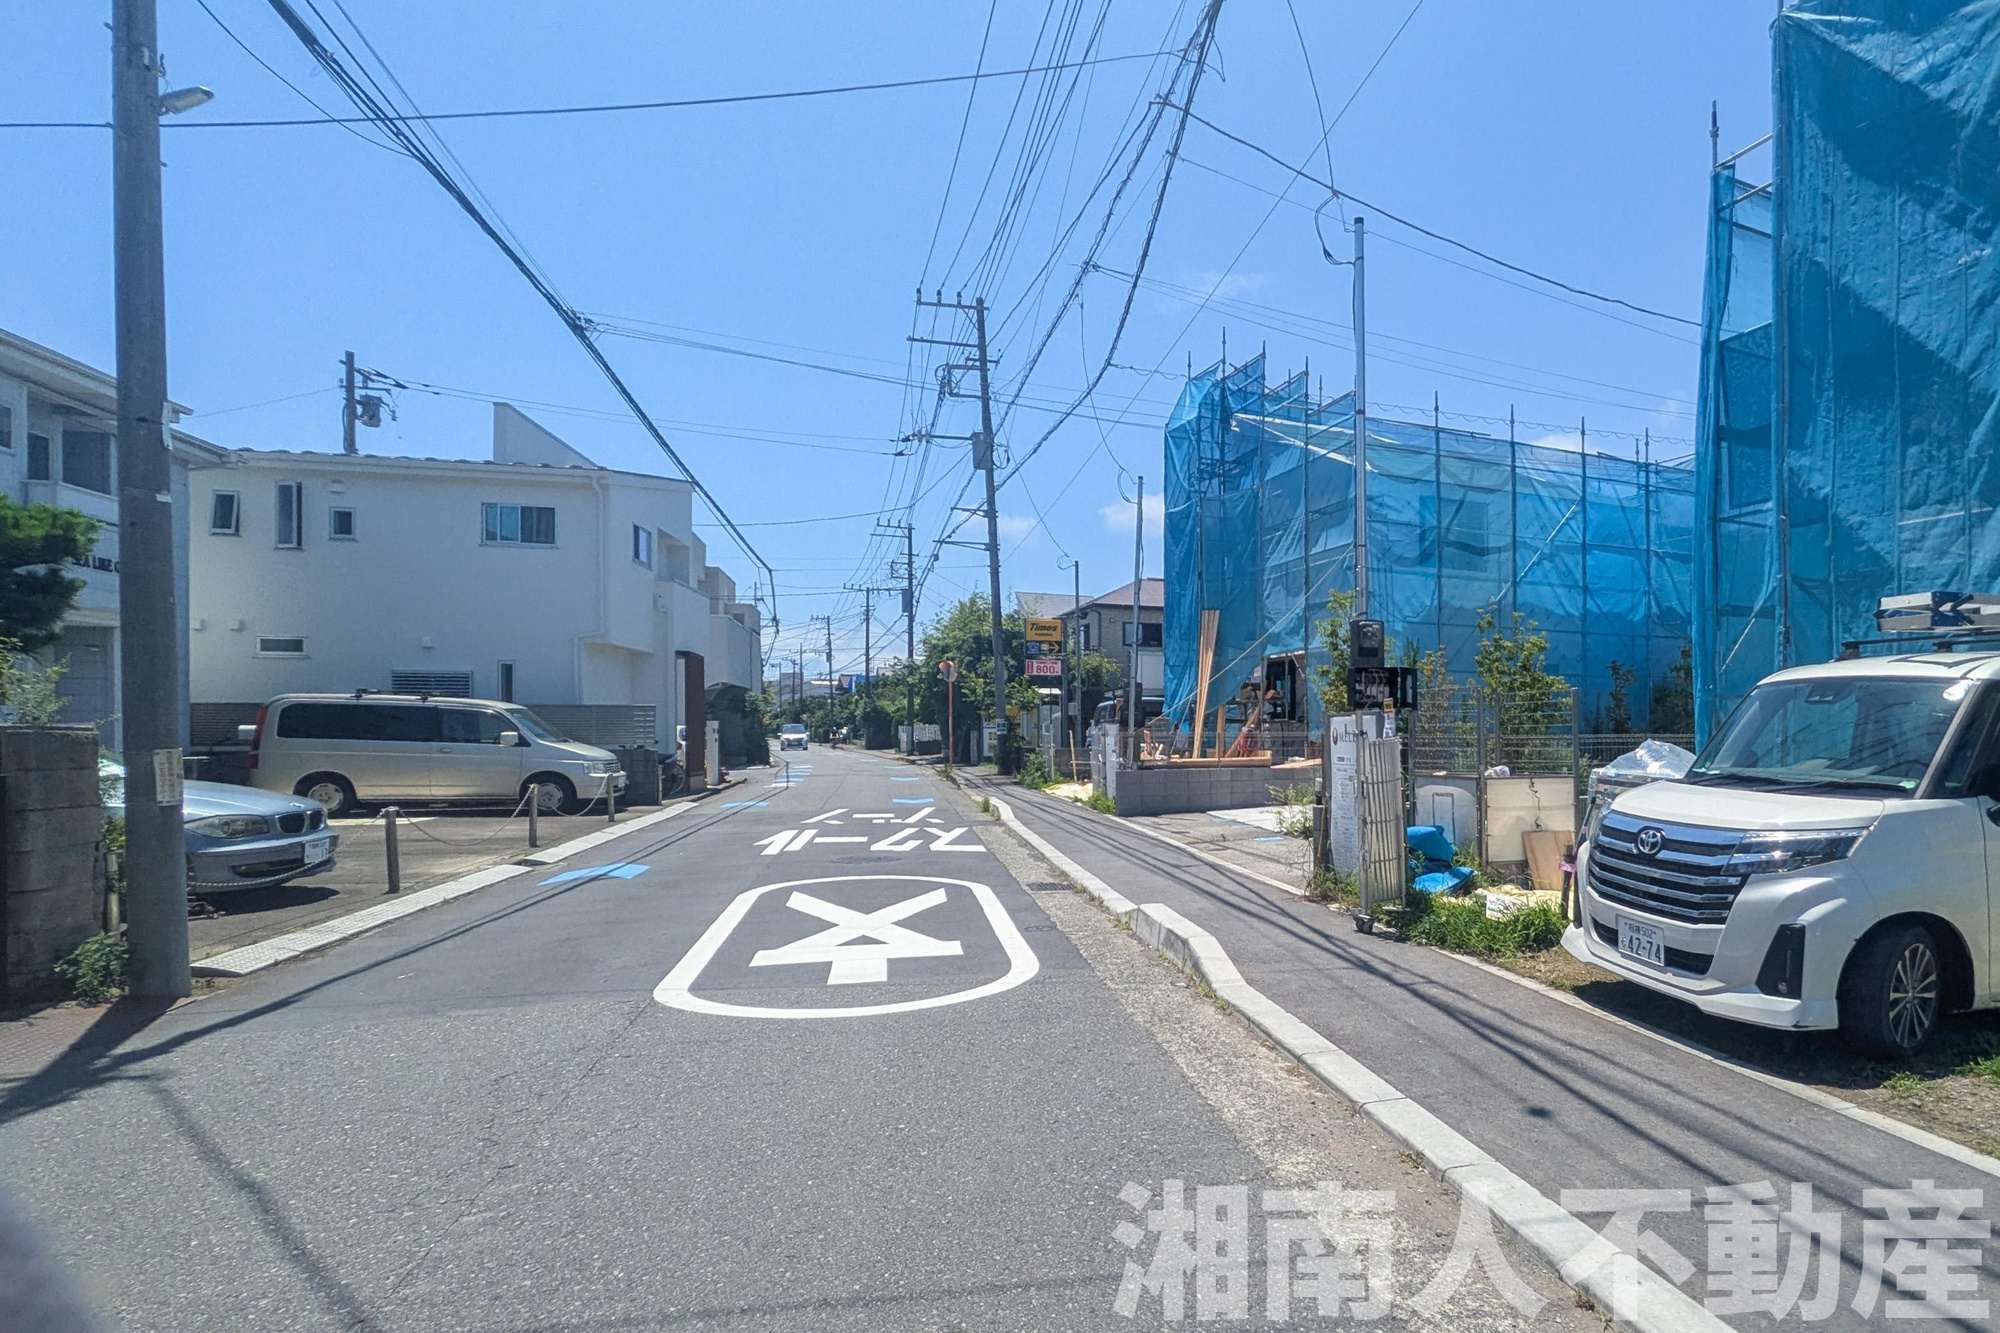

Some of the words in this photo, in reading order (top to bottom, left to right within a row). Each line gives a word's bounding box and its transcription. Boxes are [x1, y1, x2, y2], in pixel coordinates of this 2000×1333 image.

[1030, 622, 1058, 632] Times
[1036, 664, 1056, 674] 800
[799, 806, 945, 825] ゾーン
[752, 826, 988, 856] スクール
[748, 887, 964, 985] 文
[1627, 935, 1662, 963] 42-74
